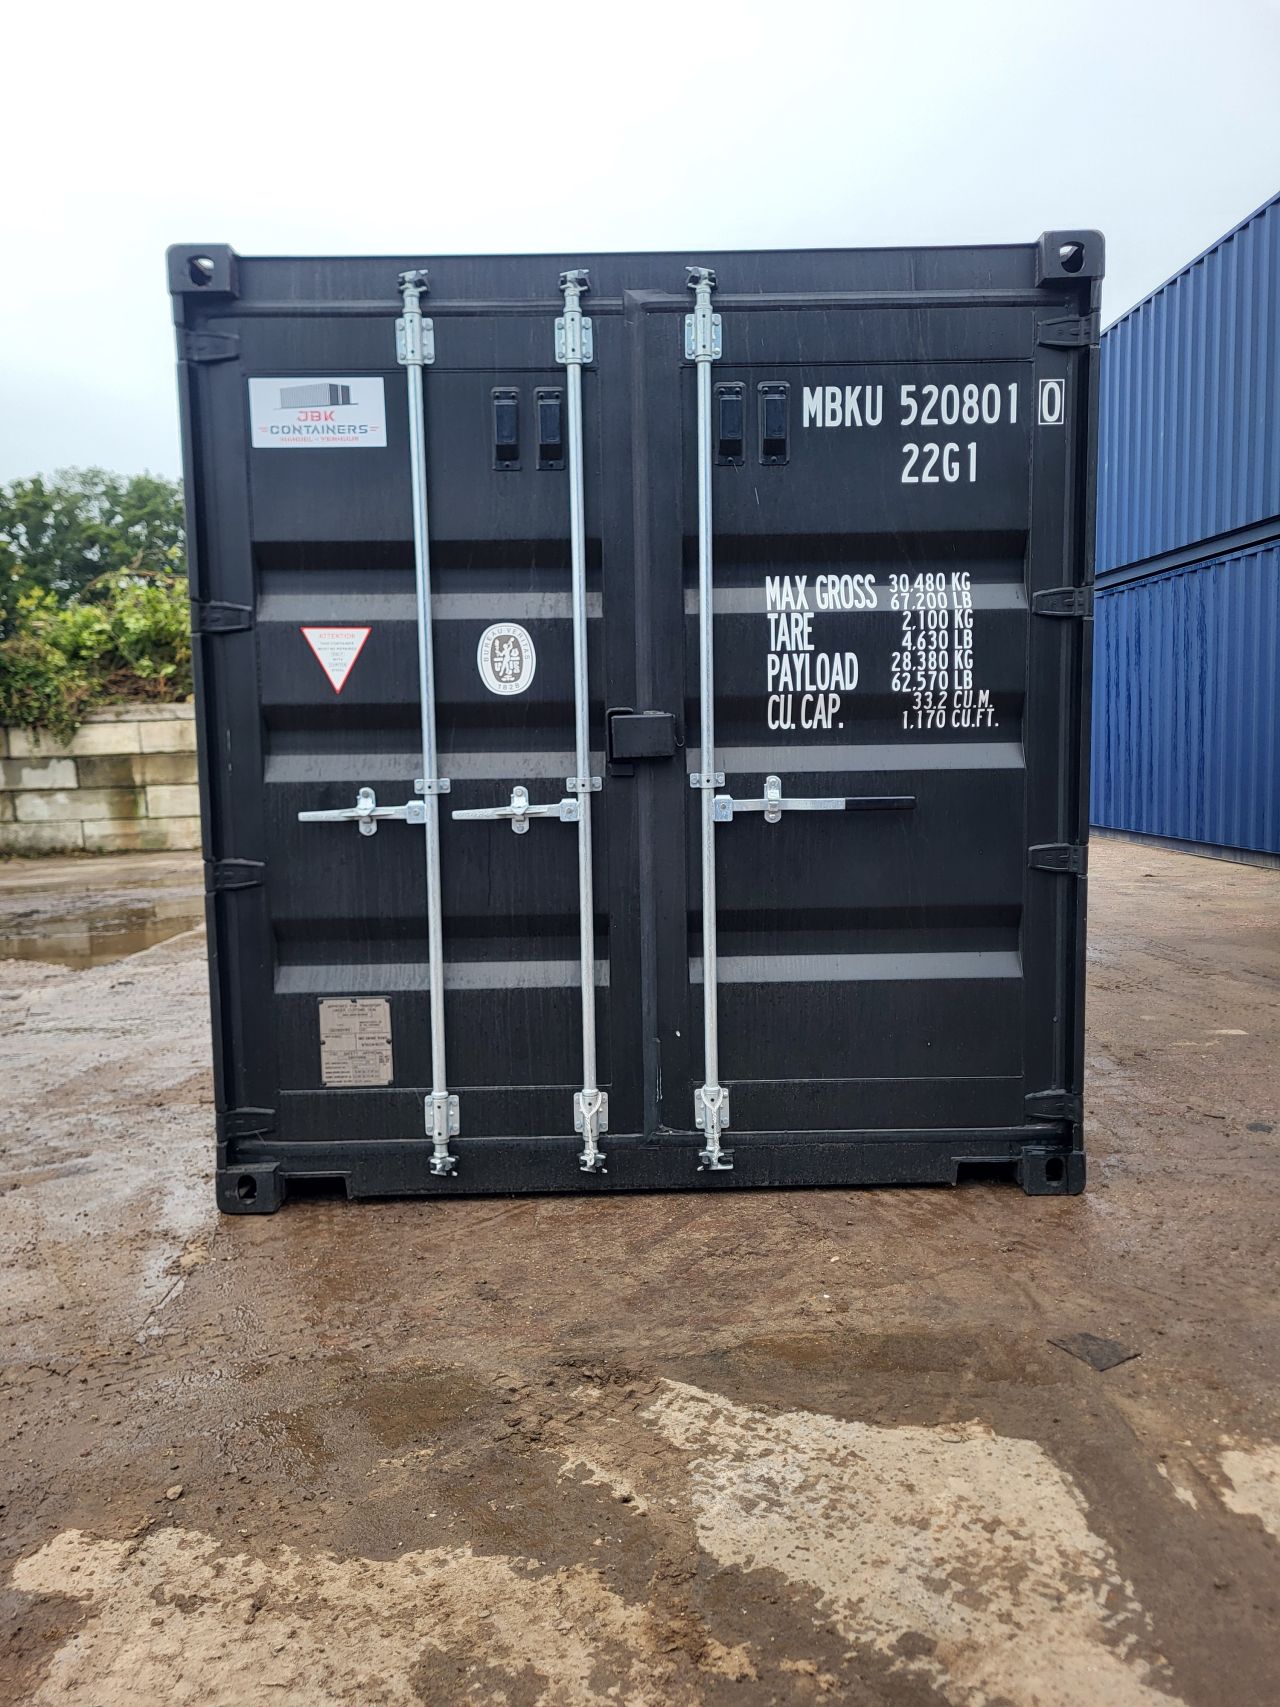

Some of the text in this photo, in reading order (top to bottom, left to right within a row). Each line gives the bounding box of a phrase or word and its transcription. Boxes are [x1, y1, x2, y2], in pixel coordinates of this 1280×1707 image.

[802, 381, 1062, 427] MBKU 520801 0
[297, 410, 335, 421] JBK
[270, 424, 368, 435] CONTAINERS
[901, 441, 977, 483] 22G1
[765, 574, 878, 610] MAX GROSS
[889, 572, 971, 592] 30,480 KG
[890, 591, 973, 610] 67,200 LB
[902, 609, 974, 631] 2,100 KG
[767, 612, 815, 651] TARE
[902, 629, 973, 651] 4,630 LB
[767, 652, 859, 692] PAYLOAD
[891, 650, 974, 672] 28,380 KG
[891, 670, 973, 693] 62,570 LB
[767, 693, 844, 729] CU. CAP.
[912, 690, 948, 710] 33.2
[902, 709, 946, 729] 1,170
